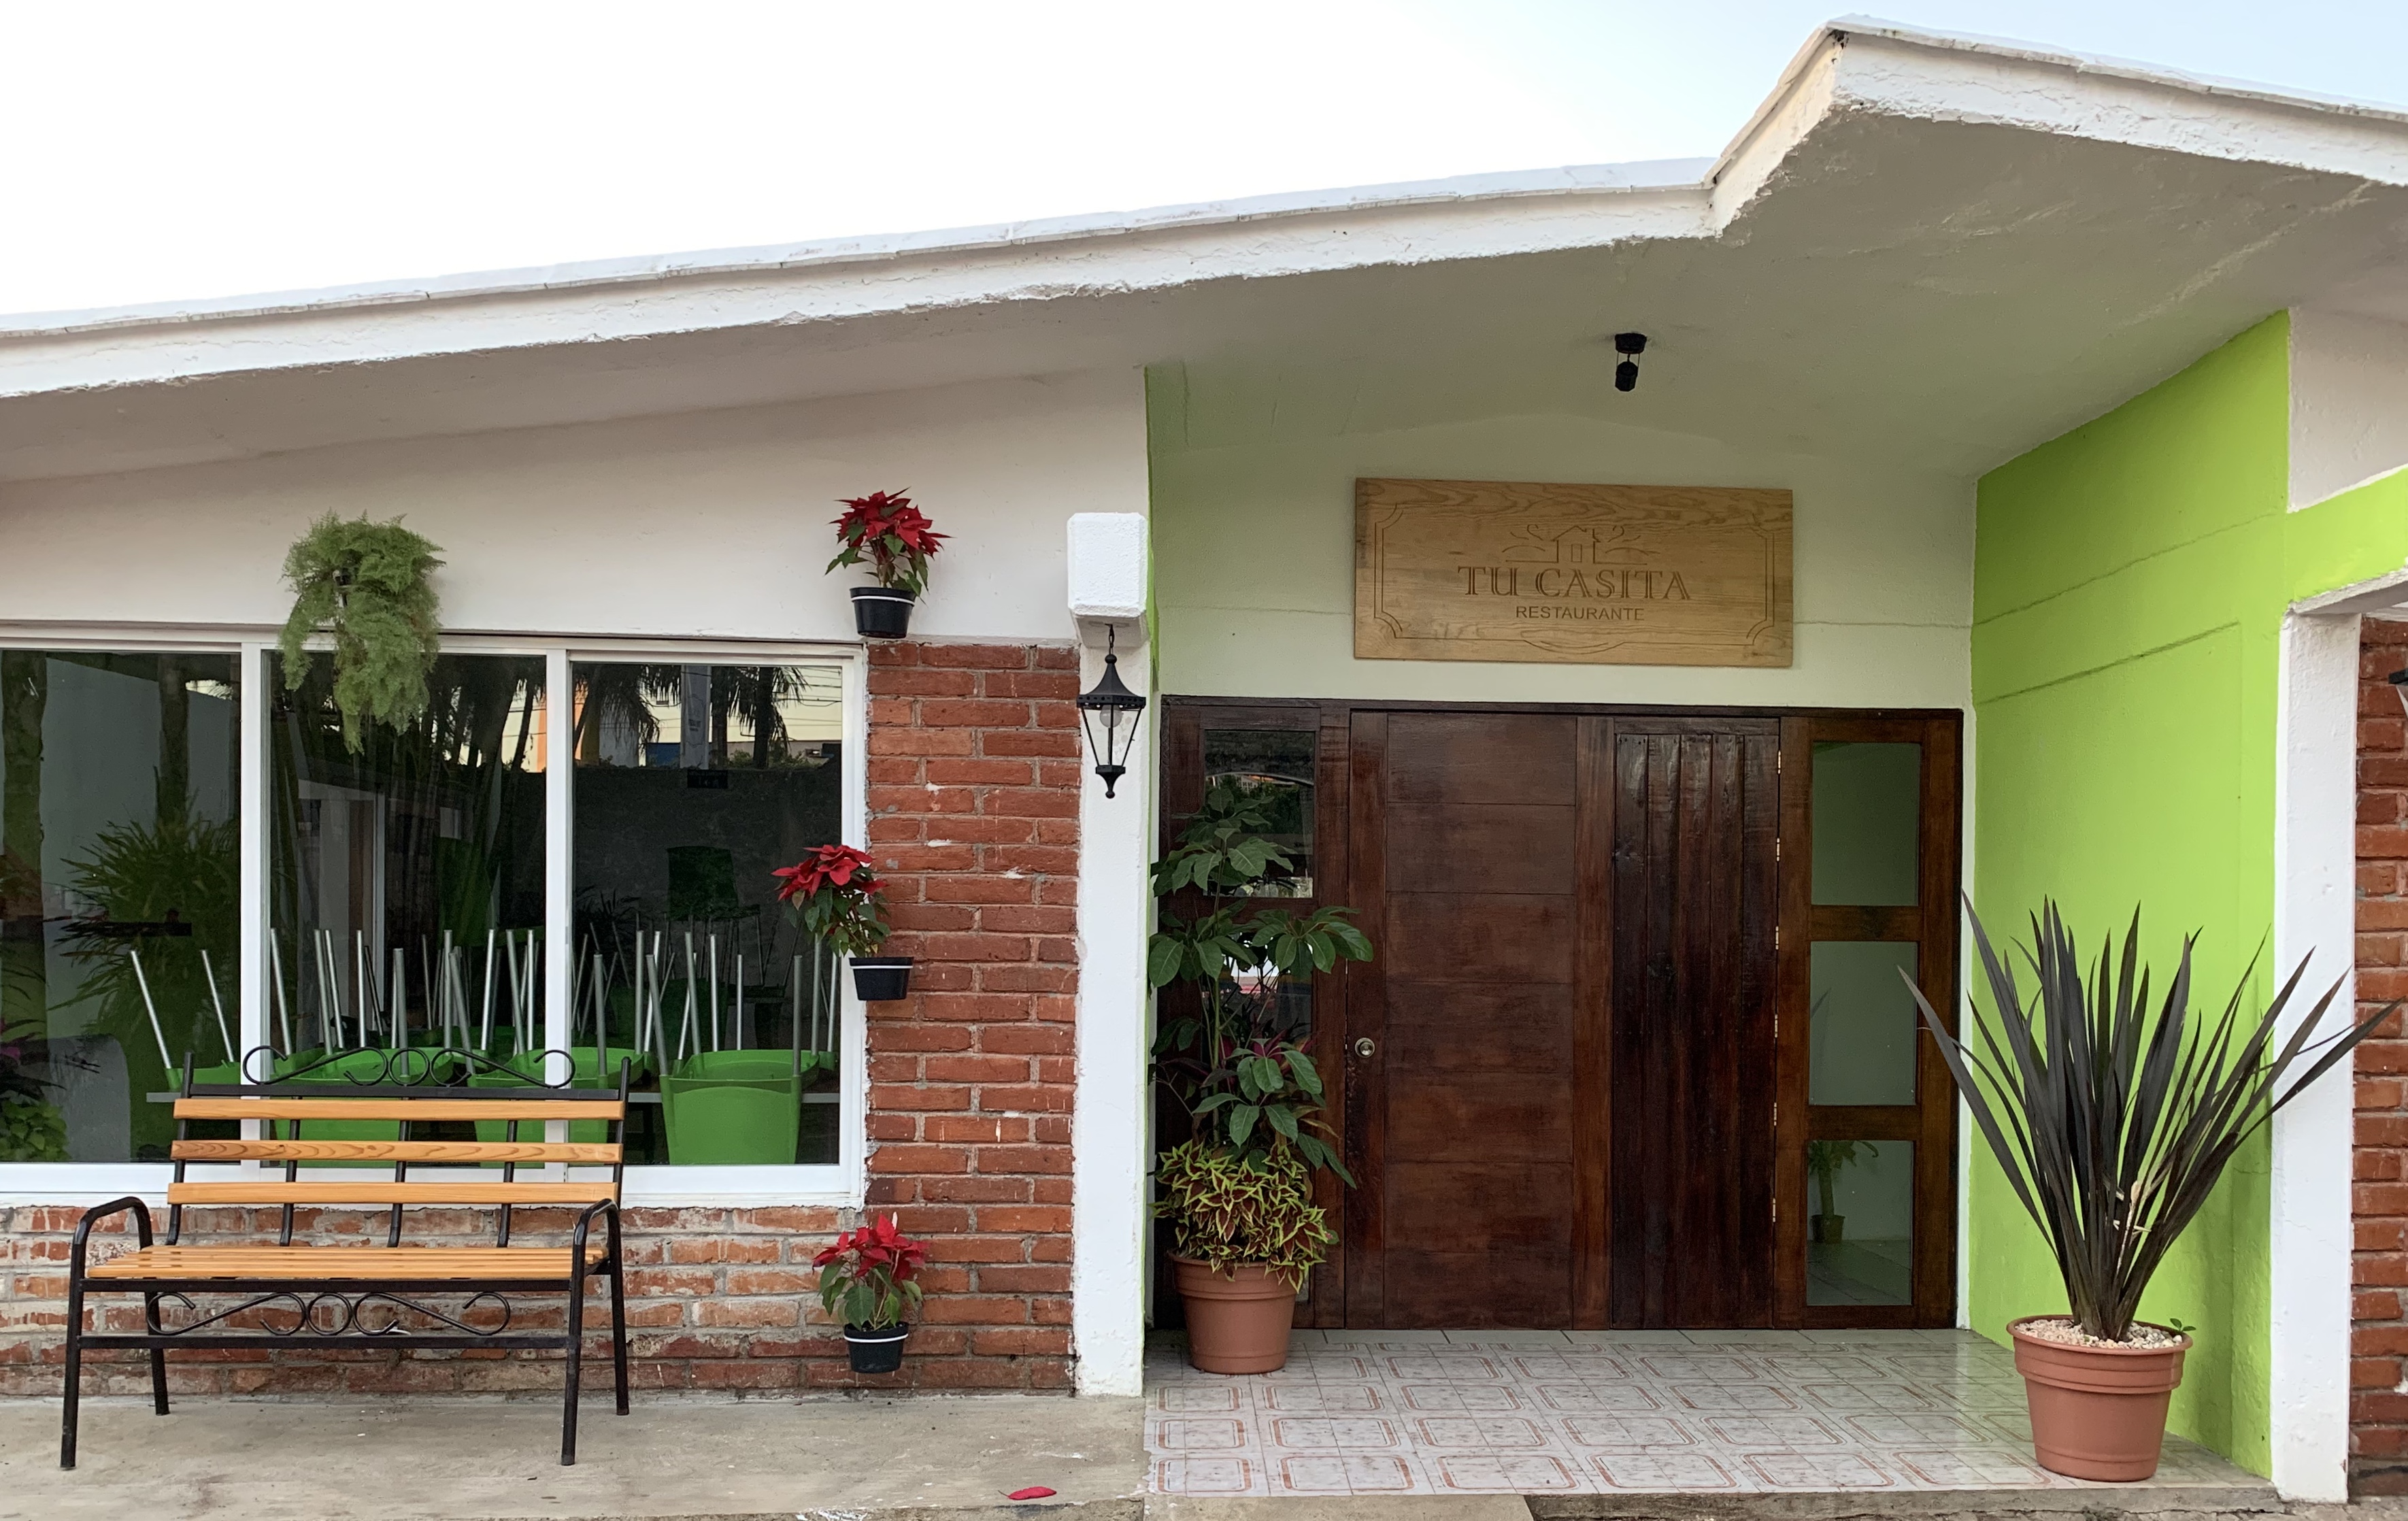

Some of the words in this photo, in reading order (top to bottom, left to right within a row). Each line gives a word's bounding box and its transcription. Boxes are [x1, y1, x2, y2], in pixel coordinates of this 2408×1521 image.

[1458, 565, 1520, 597] TU
[1535, 567, 1691, 600] CASITA
[1516, 605, 1645, 621] RESTAURANTE
